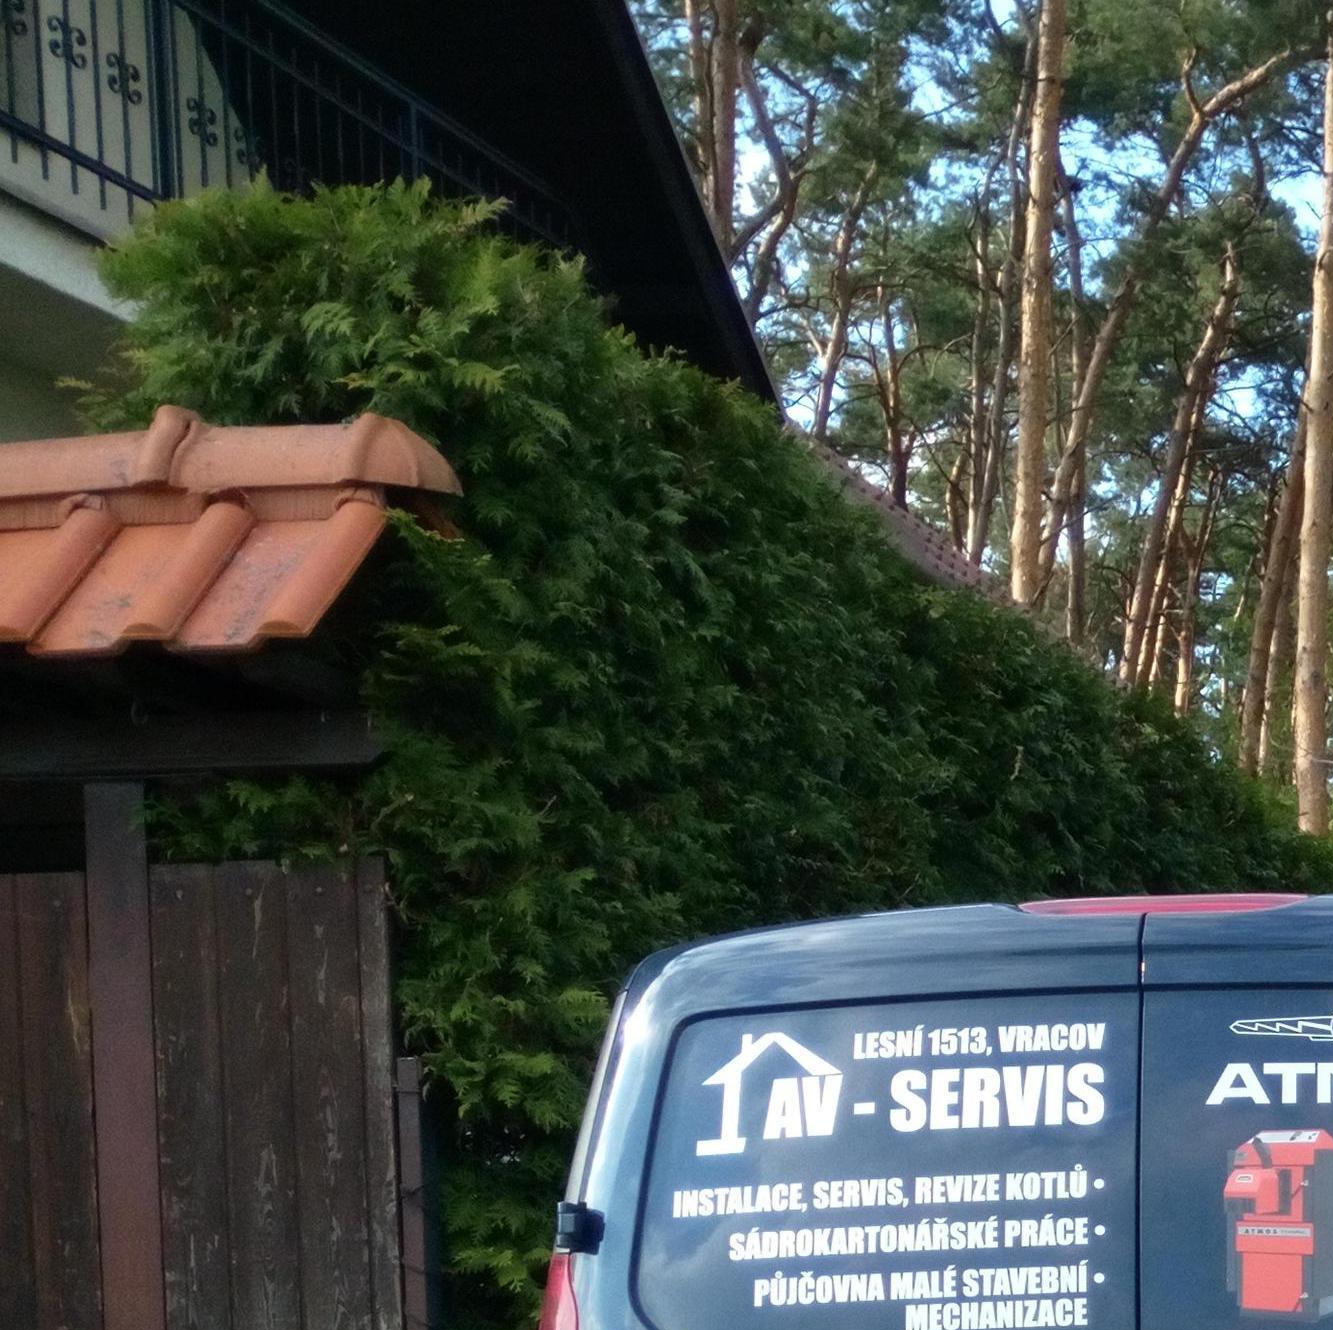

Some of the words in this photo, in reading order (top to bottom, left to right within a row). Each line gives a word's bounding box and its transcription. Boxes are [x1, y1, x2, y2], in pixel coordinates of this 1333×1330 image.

[854, 1025, 924, 1060] LESNÍ
[928, 1027, 993, 1058] 1513,
[999, 1022, 1106, 1053] VRACOV
[762, 1071, 843, 1141] AV
[889, 1062, 1106, 1132] SERVIS
[672, 1182, 808, 1219] INSTALACE,
[813, 1176, 909, 1211] SERVIS,
[915, 1172, 1000, 1205] REVIZE
[1005, 1164, 1088, 1200] KOTLŮ
[729, 1214, 998, 1261] SÁDROKARTONÁŘSKÉ
[1004, 1211, 1088, 1249] PRÁCE
[753, 1270, 884, 1307] PŮJČOVNA
[890, 1265, 956, 1300] MALÉ
[963, 1259, 1088, 1298] STAVEBNÍ
